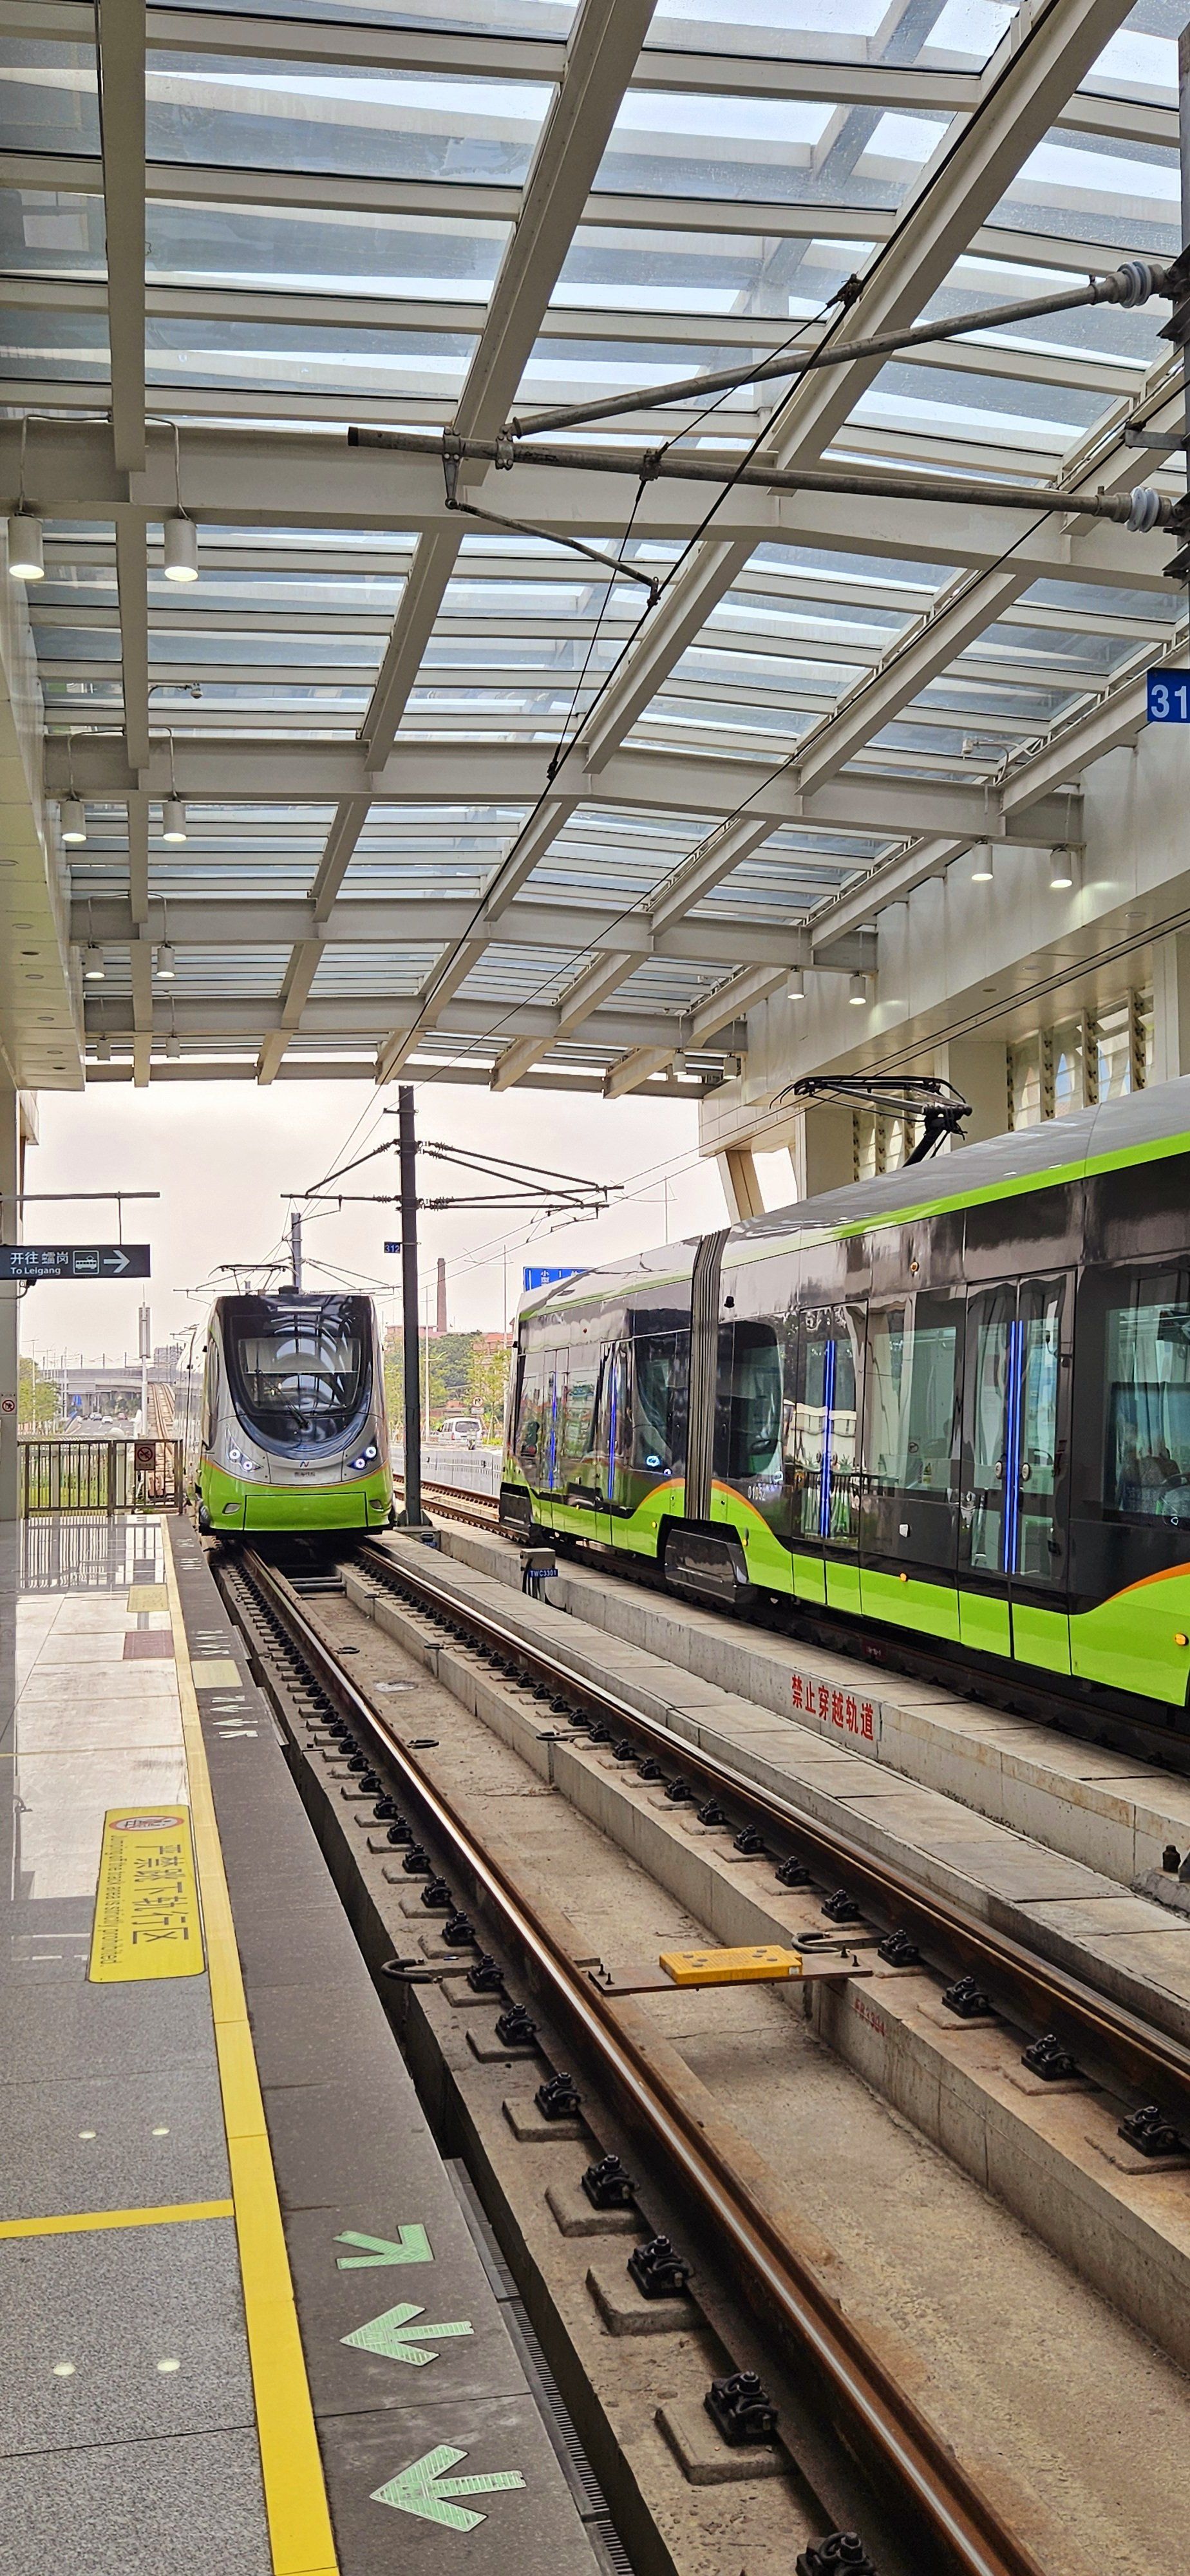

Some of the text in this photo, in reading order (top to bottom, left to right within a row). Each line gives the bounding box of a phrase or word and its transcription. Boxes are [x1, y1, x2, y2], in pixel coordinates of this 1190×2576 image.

[1151, 684, 1187, 719] 31
[384, 1244, 400, 1253] 312
[24, 1267, 61, 1276] Leigang
[791, 1674, 874, 1741] 禁止穿越轨道
[107, 1871, 126, 1885] track
[105, 1886, 121, 1899] area
[131, 1844, 189, 1944] 严禁跳下轨行区
[98, 1906, 124, 1927] strictly
